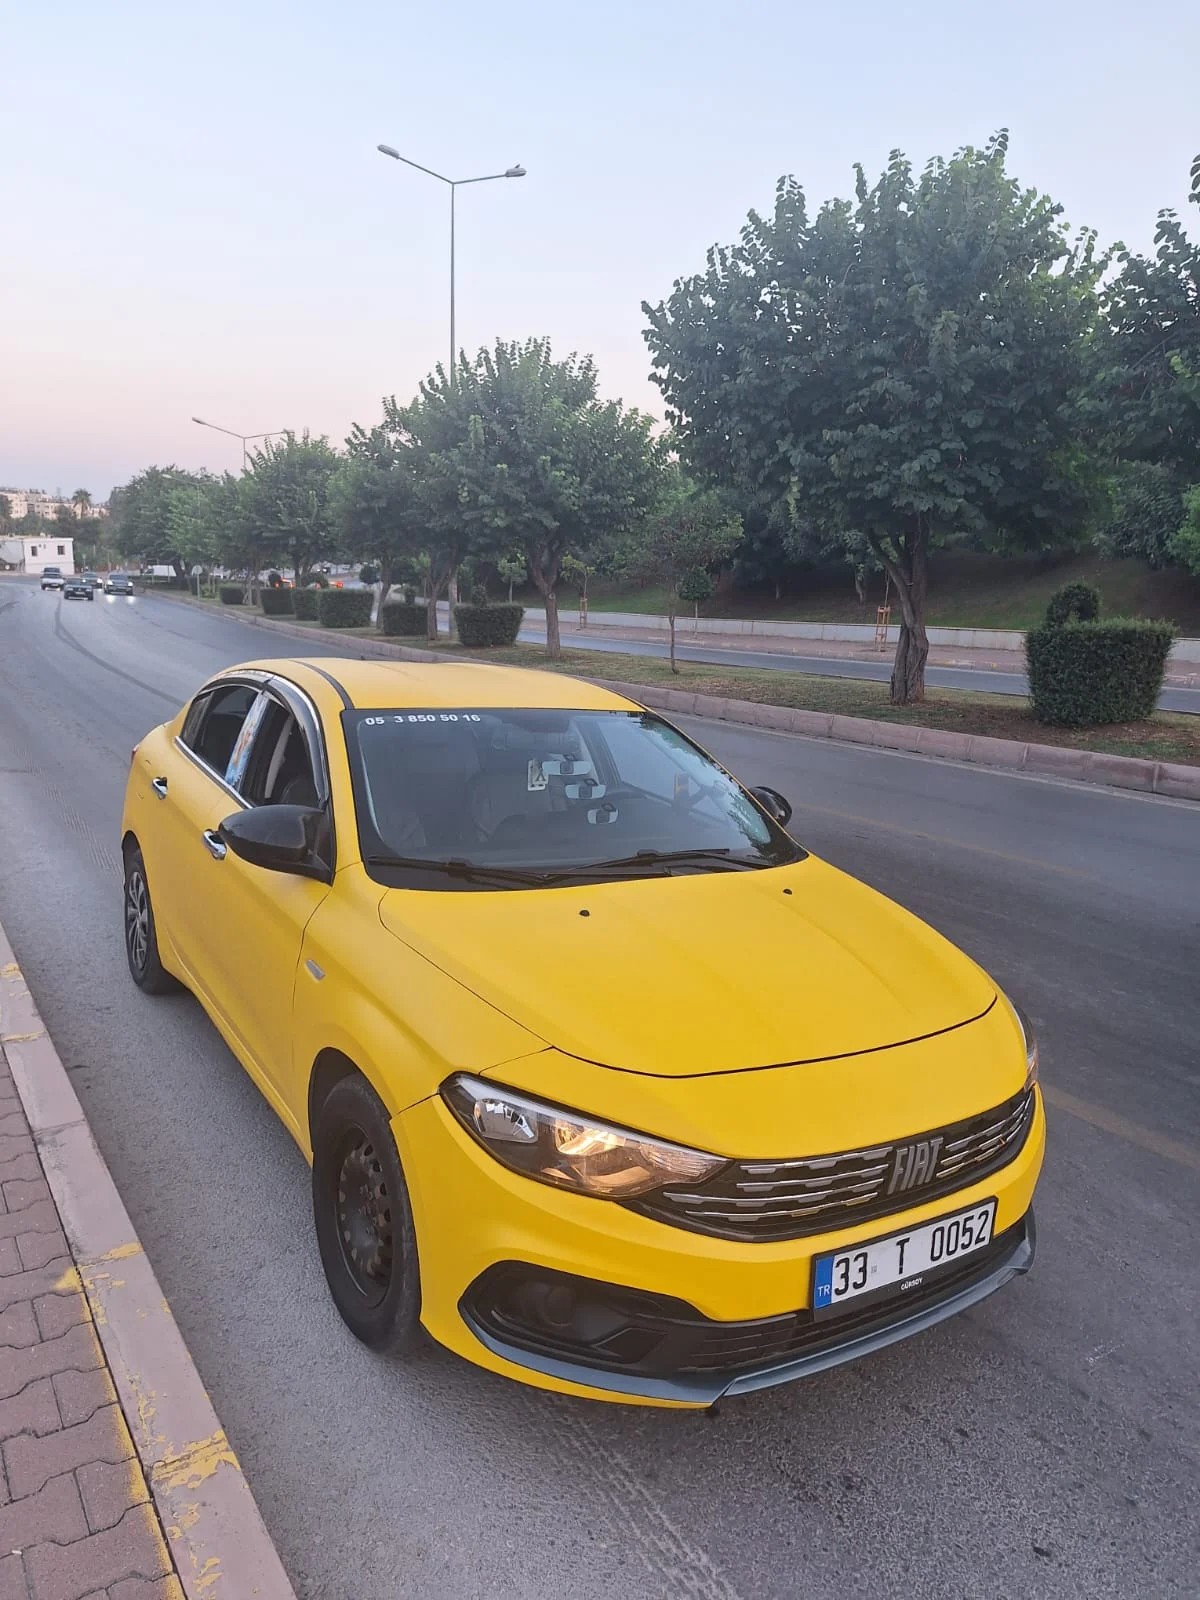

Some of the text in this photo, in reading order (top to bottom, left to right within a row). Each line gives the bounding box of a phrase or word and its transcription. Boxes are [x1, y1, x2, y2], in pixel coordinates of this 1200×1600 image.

[365, 714, 481, 726] 05 3 850 50 16
[887, 1136, 944, 1196] FIAT
[817, 1209, 990, 1297] TR 33 T 0052
